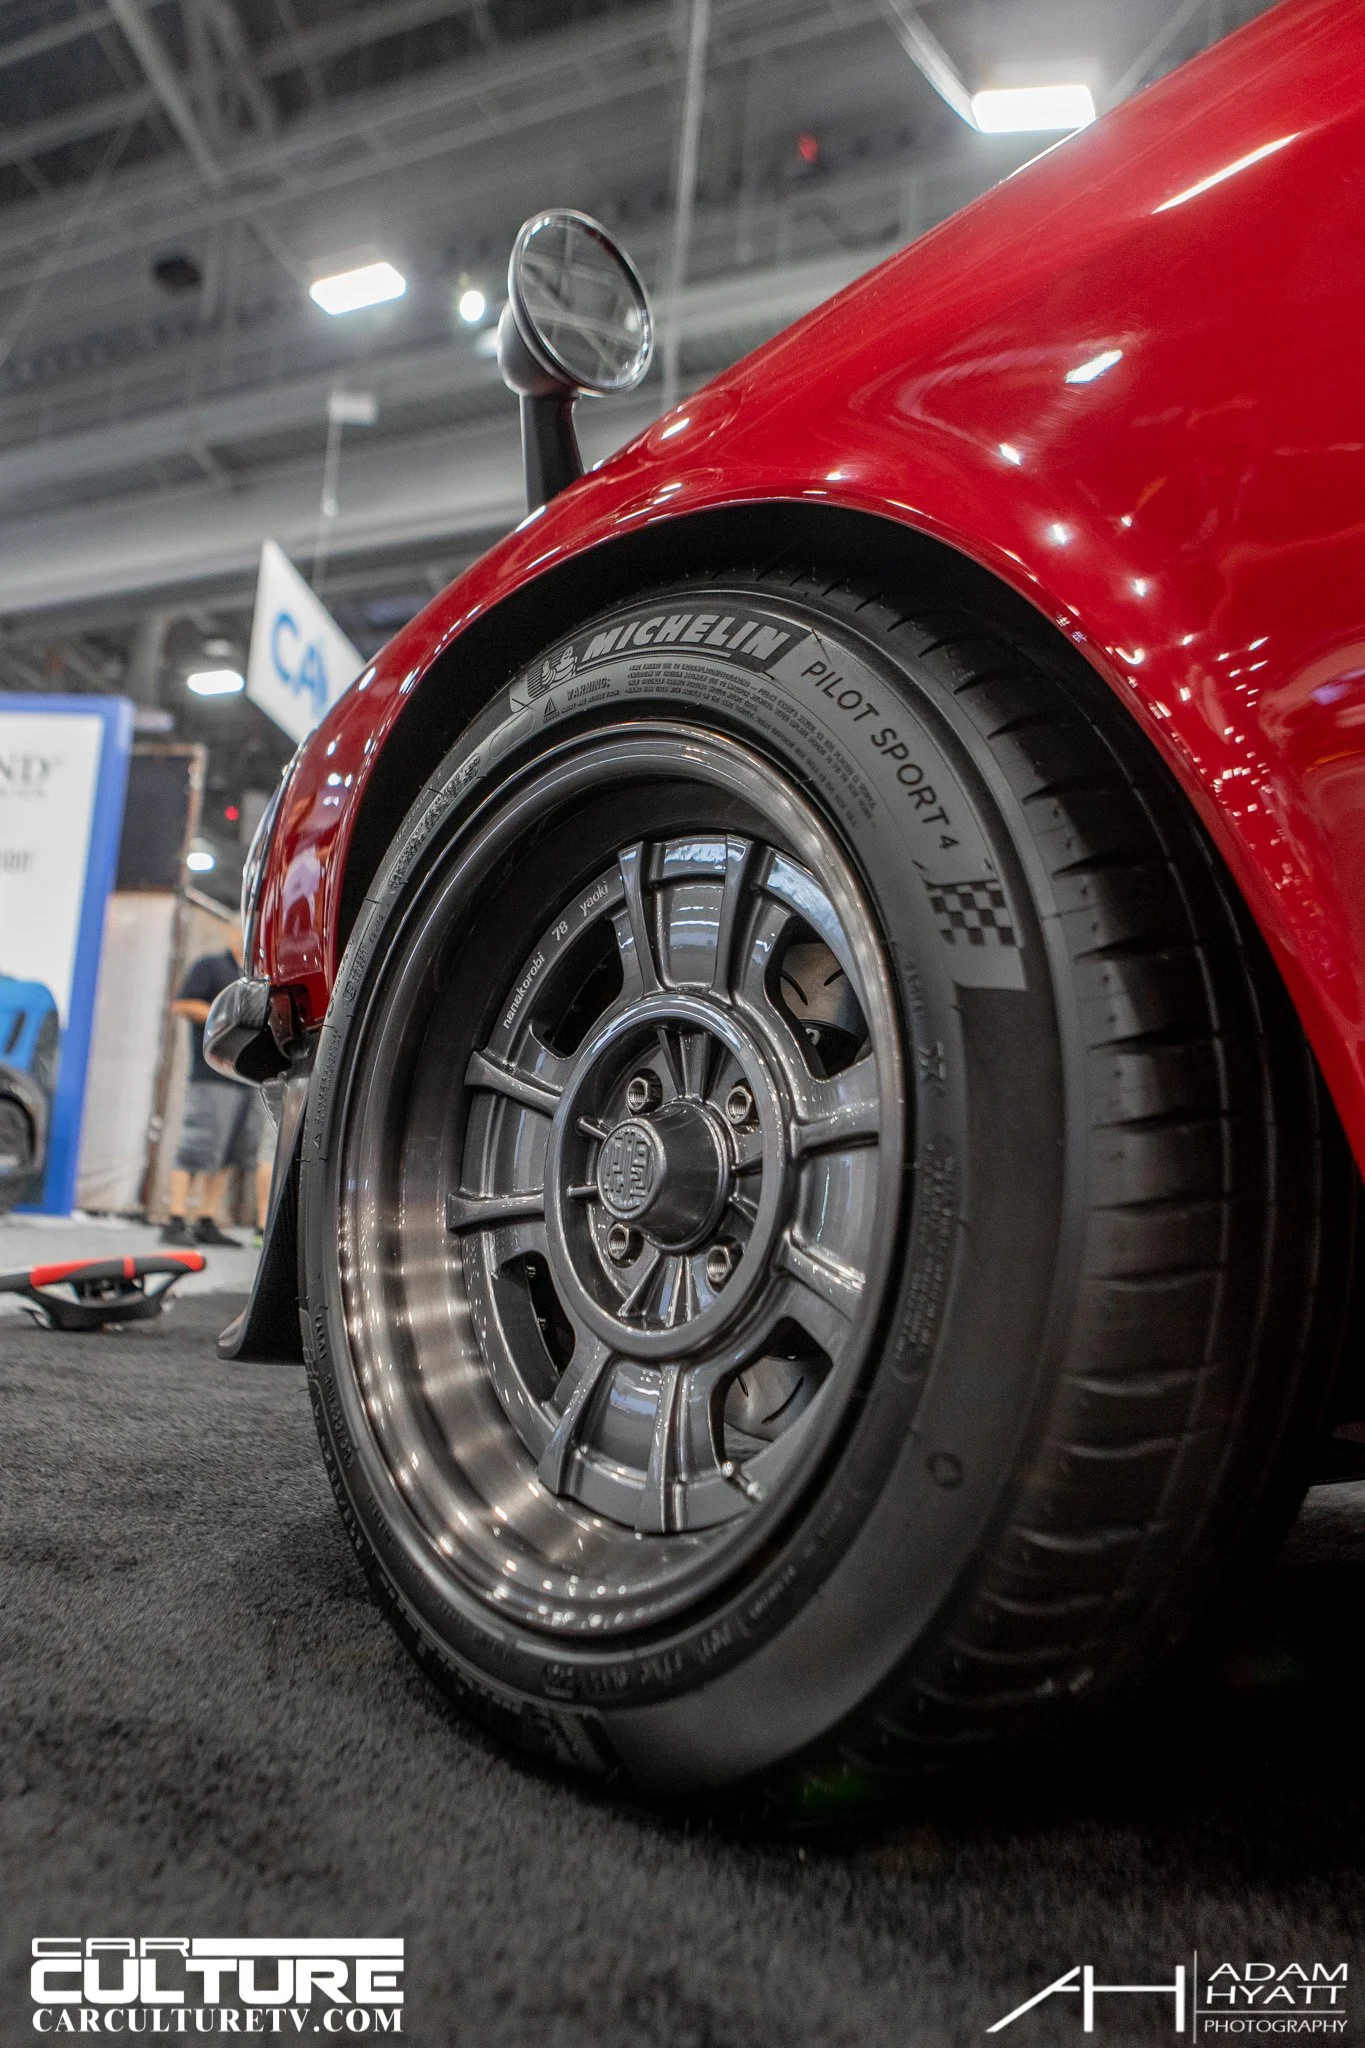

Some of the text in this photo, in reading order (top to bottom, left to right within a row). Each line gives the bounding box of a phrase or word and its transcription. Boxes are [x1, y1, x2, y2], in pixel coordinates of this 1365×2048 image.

[582, 614, 792, 662] MICHELIN
[801, 660, 881, 722] PILOT
[871, 727, 951, 826] SPORT
[939, 834, 960, 851] 4
[503, 880, 609, 1029] nanakorobi 78 yaoki
